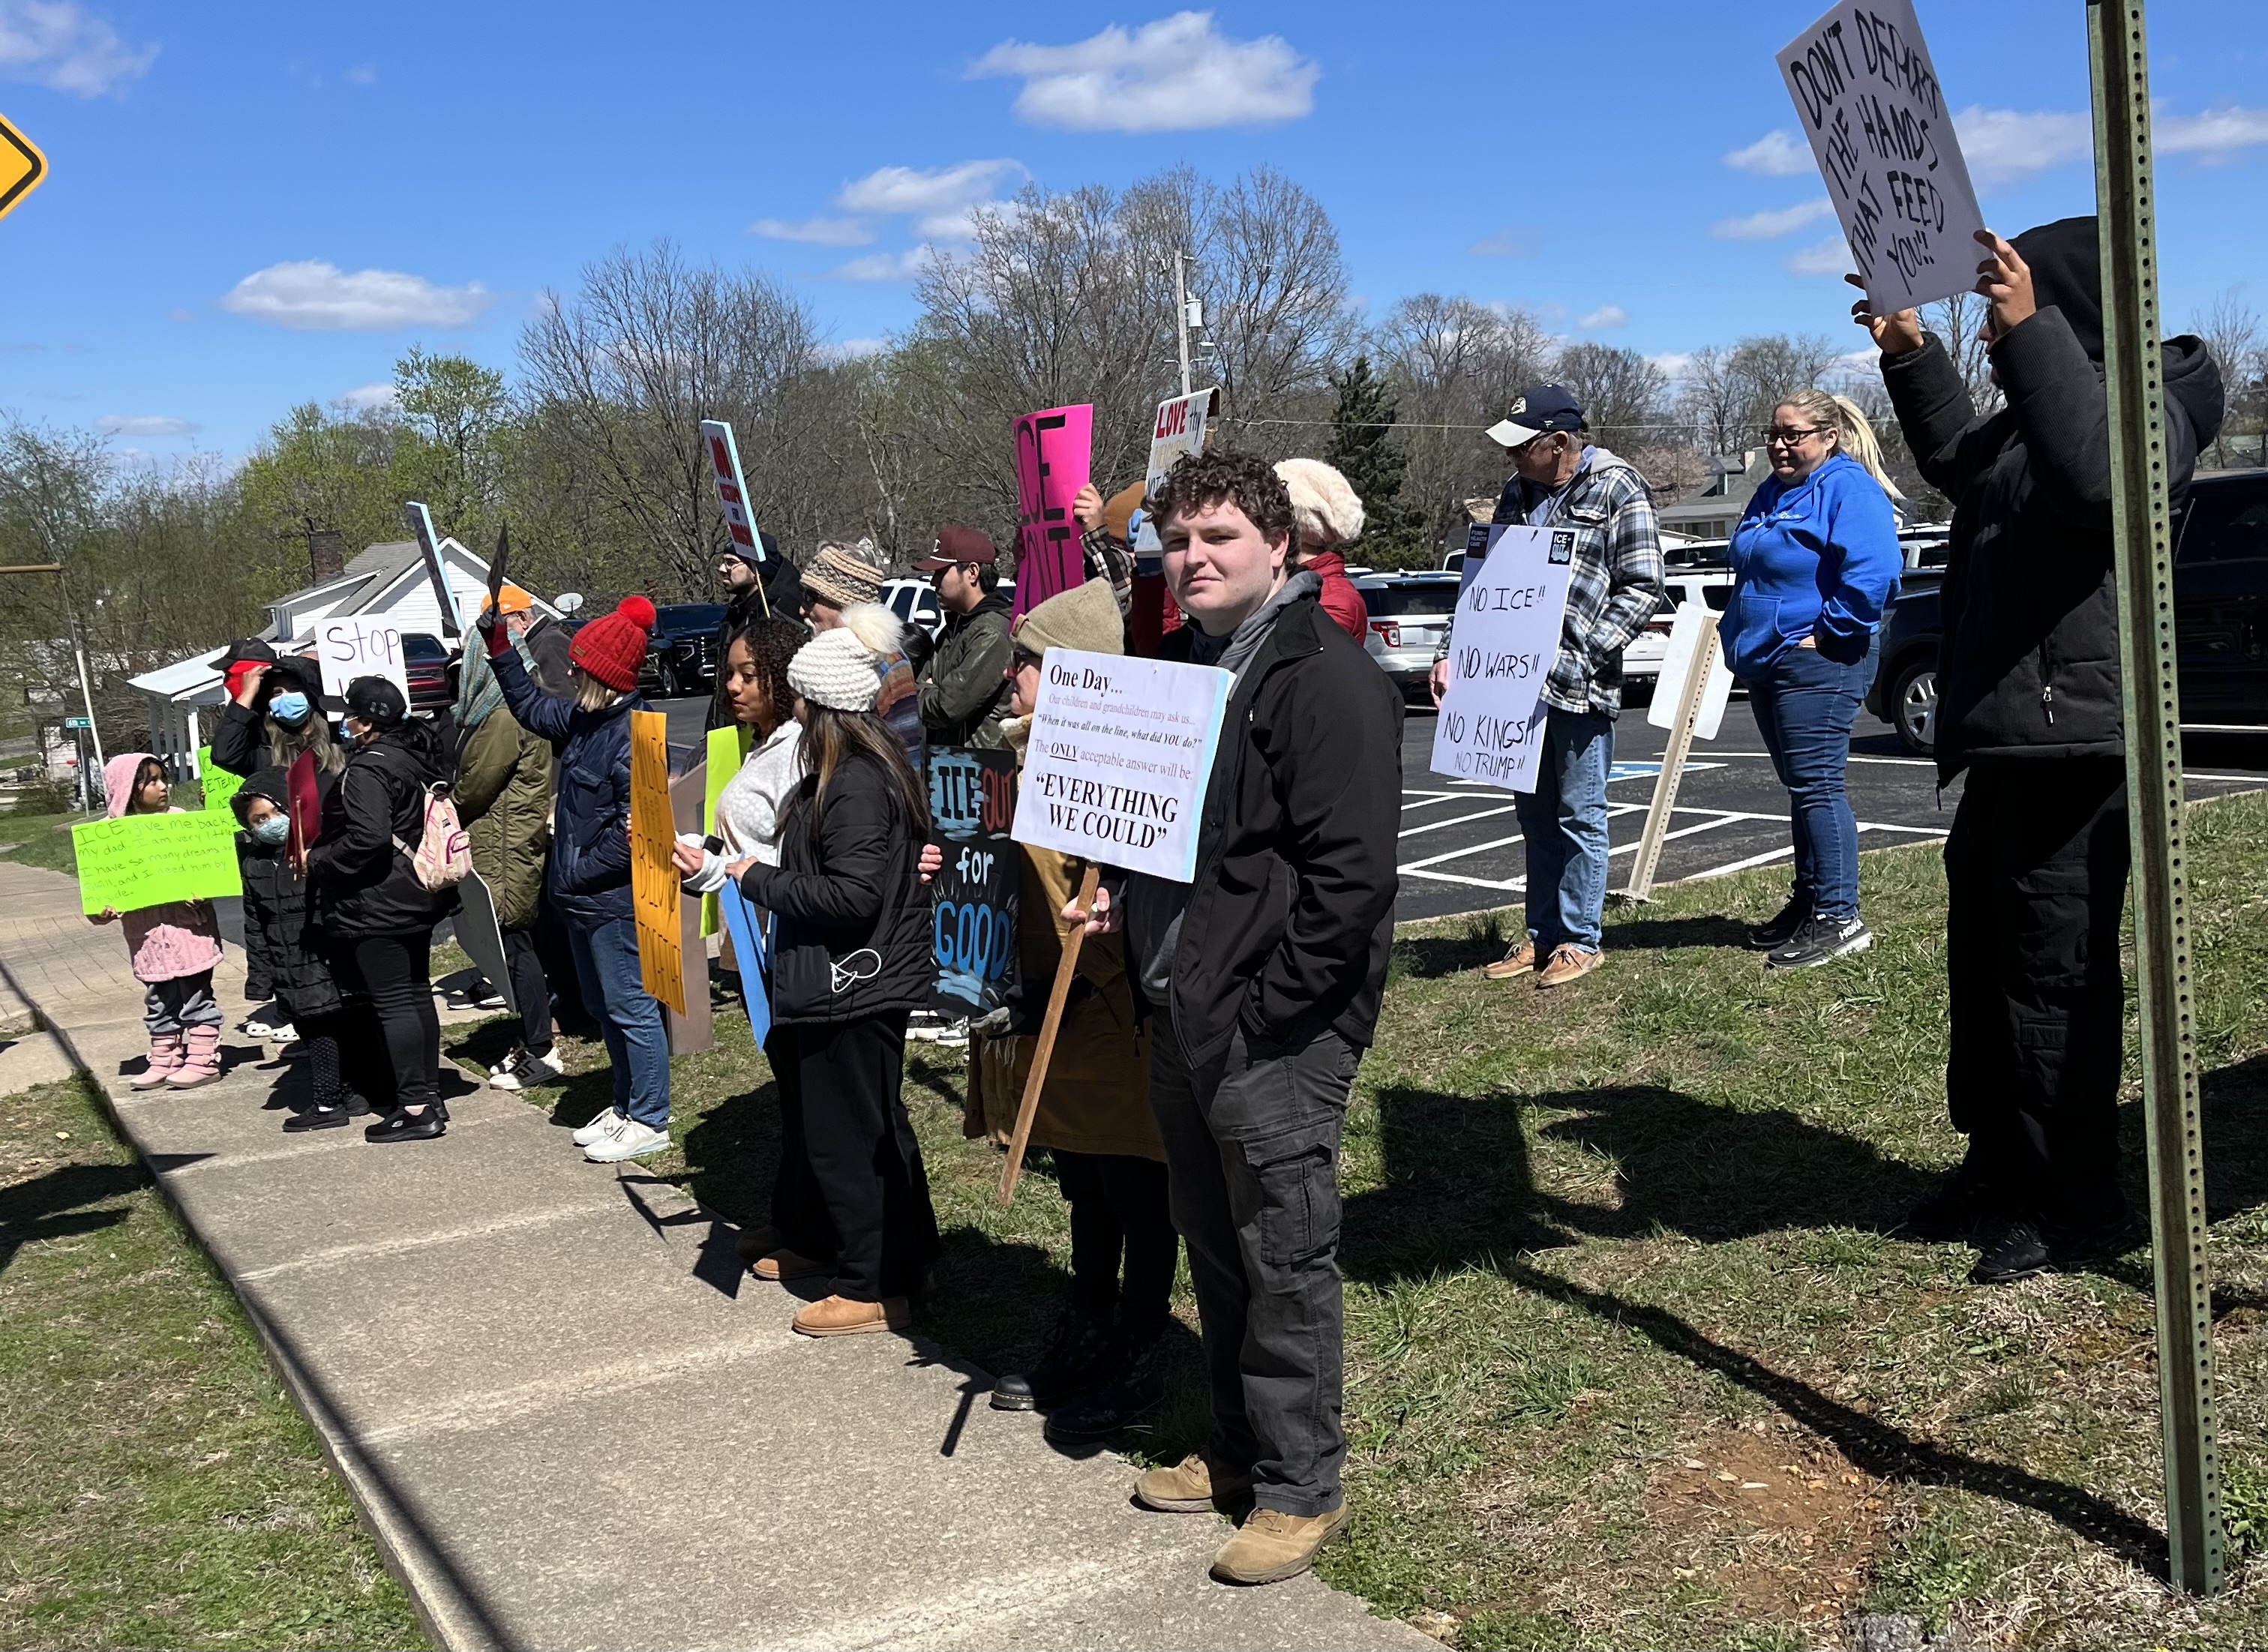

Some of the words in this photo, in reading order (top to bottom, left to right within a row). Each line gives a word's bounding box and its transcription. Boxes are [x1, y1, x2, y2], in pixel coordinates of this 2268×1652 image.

[1790, 19, 1856, 130] DON'T
[1854, 8, 1940, 119] DEPORT
[1826, 106, 1858, 199] THE
[1855, 94, 1939, 172] HANDS
[1850, 170, 1884, 280] THAT
[1886, 169, 1944, 234] FEED
[1156, 400, 1188, 439] LOVE
[1469, 585, 1487, 611] NO
[1492, 585, 1546, 611] ICE!!
[1456, 646, 1480, 679] NO
[1485, 652, 1540, 679] WARS!!
[1050, 664, 1078, 687] One
[1082, 667, 1123, 697] Day...
[1049, 694, 1060, 704] Our
[1062, 695, 1088, 709] children
[1090, 700, 1101, 711] and
[1102, 703, 1149, 718] grandchildren
[1150, 710, 1166, 723] may
[1168, 712, 1179, 722] ask
[1061, 717, 1066, 726] it
[1067, 720, 1079, 729] was
[1081, 721, 1090, 731] all
[1091, 724, 1100, 733] on
[1102, 724, 1112, 735] the
[1114, 725, 1129, 739] line,
[1132, 729, 1149, 740] what
[1150, 732, 1162, 743] did
[1164, 734, 1182, 746] YOU
[1443, 711, 1465, 743] NO
[1035, 739, 1048, 754] The
[1050, 742, 1079, 759] ONLY
[1080, 748, 1124, 767] acceptable
[1126, 759, 1157, 774] answer
[1160, 762, 1177, 778] will
[1179, 766, 1193, 781] be:
[1454, 750, 1472, 772] NO
[938, 765, 979, 821] ICE
[982, 767, 1015, 832] OUT
[1036, 772, 1179, 823] “EVERYTHING
[132, 820, 165, 837] give
[170, 819, 193, 829] me
[196, 815, 230, 829] back
[132, 838, 148, 849] I
[152, 837, 170, 845] am
[176, 834, 201, 844] very
[1049, 803, 1078, 832] WE
[1083, 811, 1167, 849] COULD”
[79, 867, 93, 877] I
[94, 863, 127, 876] have
[182, 847, 219, 859] dreams
[118, 872, 139, 886] and
[142, 871, 153, 880] I
[158, 865, 187, 876] need
[214, 860, 227, 872] by
[956, 846, 994, 886] for
[935, 900, 1010, 981] GOOD
